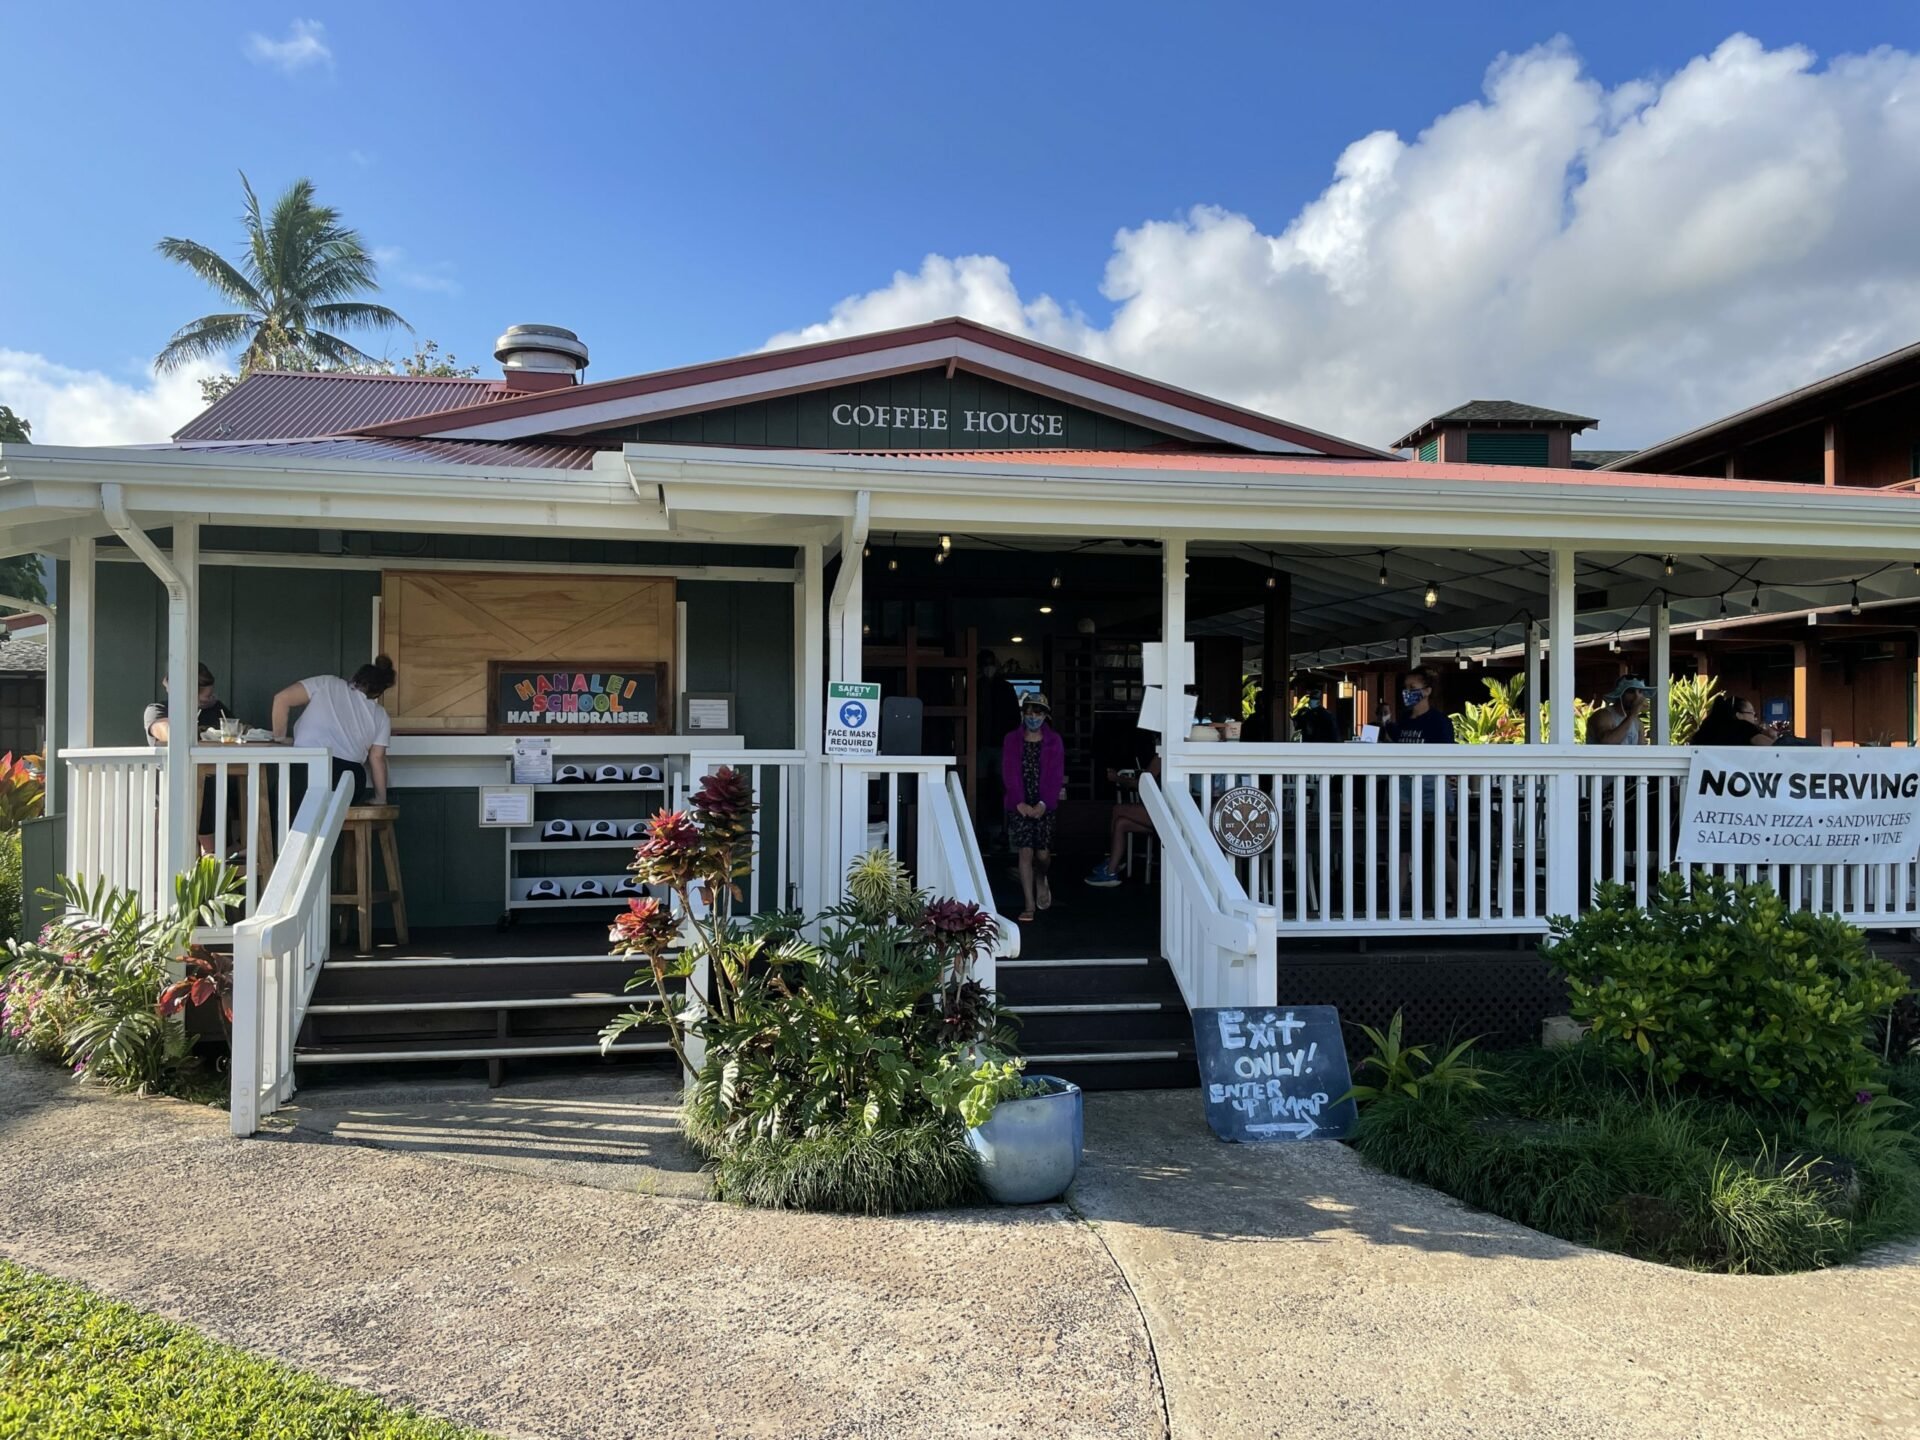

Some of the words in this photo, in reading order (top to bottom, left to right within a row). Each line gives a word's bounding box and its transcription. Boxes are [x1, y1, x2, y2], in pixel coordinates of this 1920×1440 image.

[832, 404, 948, 430] COFFEE
[963, 410, 1064, 436] HOUSE
[514, 673, 638, 701] HANALEI
[838, 685, 871, 693] SAFETY
[532, 693, 624, 712] SCHOOL
[507, 711, 540, 724] HAT
[545, 711, 649, 724] FUNDRAISER
[828, 729, 847, 737] FACE
[849, 730, 877, 738] MASKS
[830, 738, 873, 747] REQUIRED
[1698, 769, 1783, 799] NOW
[1788, 772, 1920, 800] SERVING
[1222, 795, 1268, 814] HANALEI
[1224, 789, 1247, 803] ARTISAN
[1693, 810, 1768, 827] ARTISAN
[1770, 813, 1814, 828] PIZZA
[1825, 812, 1912, 828] SANDWICHES
[1225, 831, 1252, 848] BREAD
[1697, 829, 1761, 846] SALADS
[1772, 833, 1823, 847] LOCAL
[1826, 833, 1860, 847] BEER
[1872, 831, 1903, 845] WINE
[1228, 845, 1246, 854] COFFEE
[1246, 845, 1263, 854] HOUSE
[1234, 1042, 1318, 1078] ONLY!
[1209, 1079, 1283, 1104] ENTER
[1231, 1098, 1260, 1118] UP
[1268, 1092, 1329, 1119] RAMP
